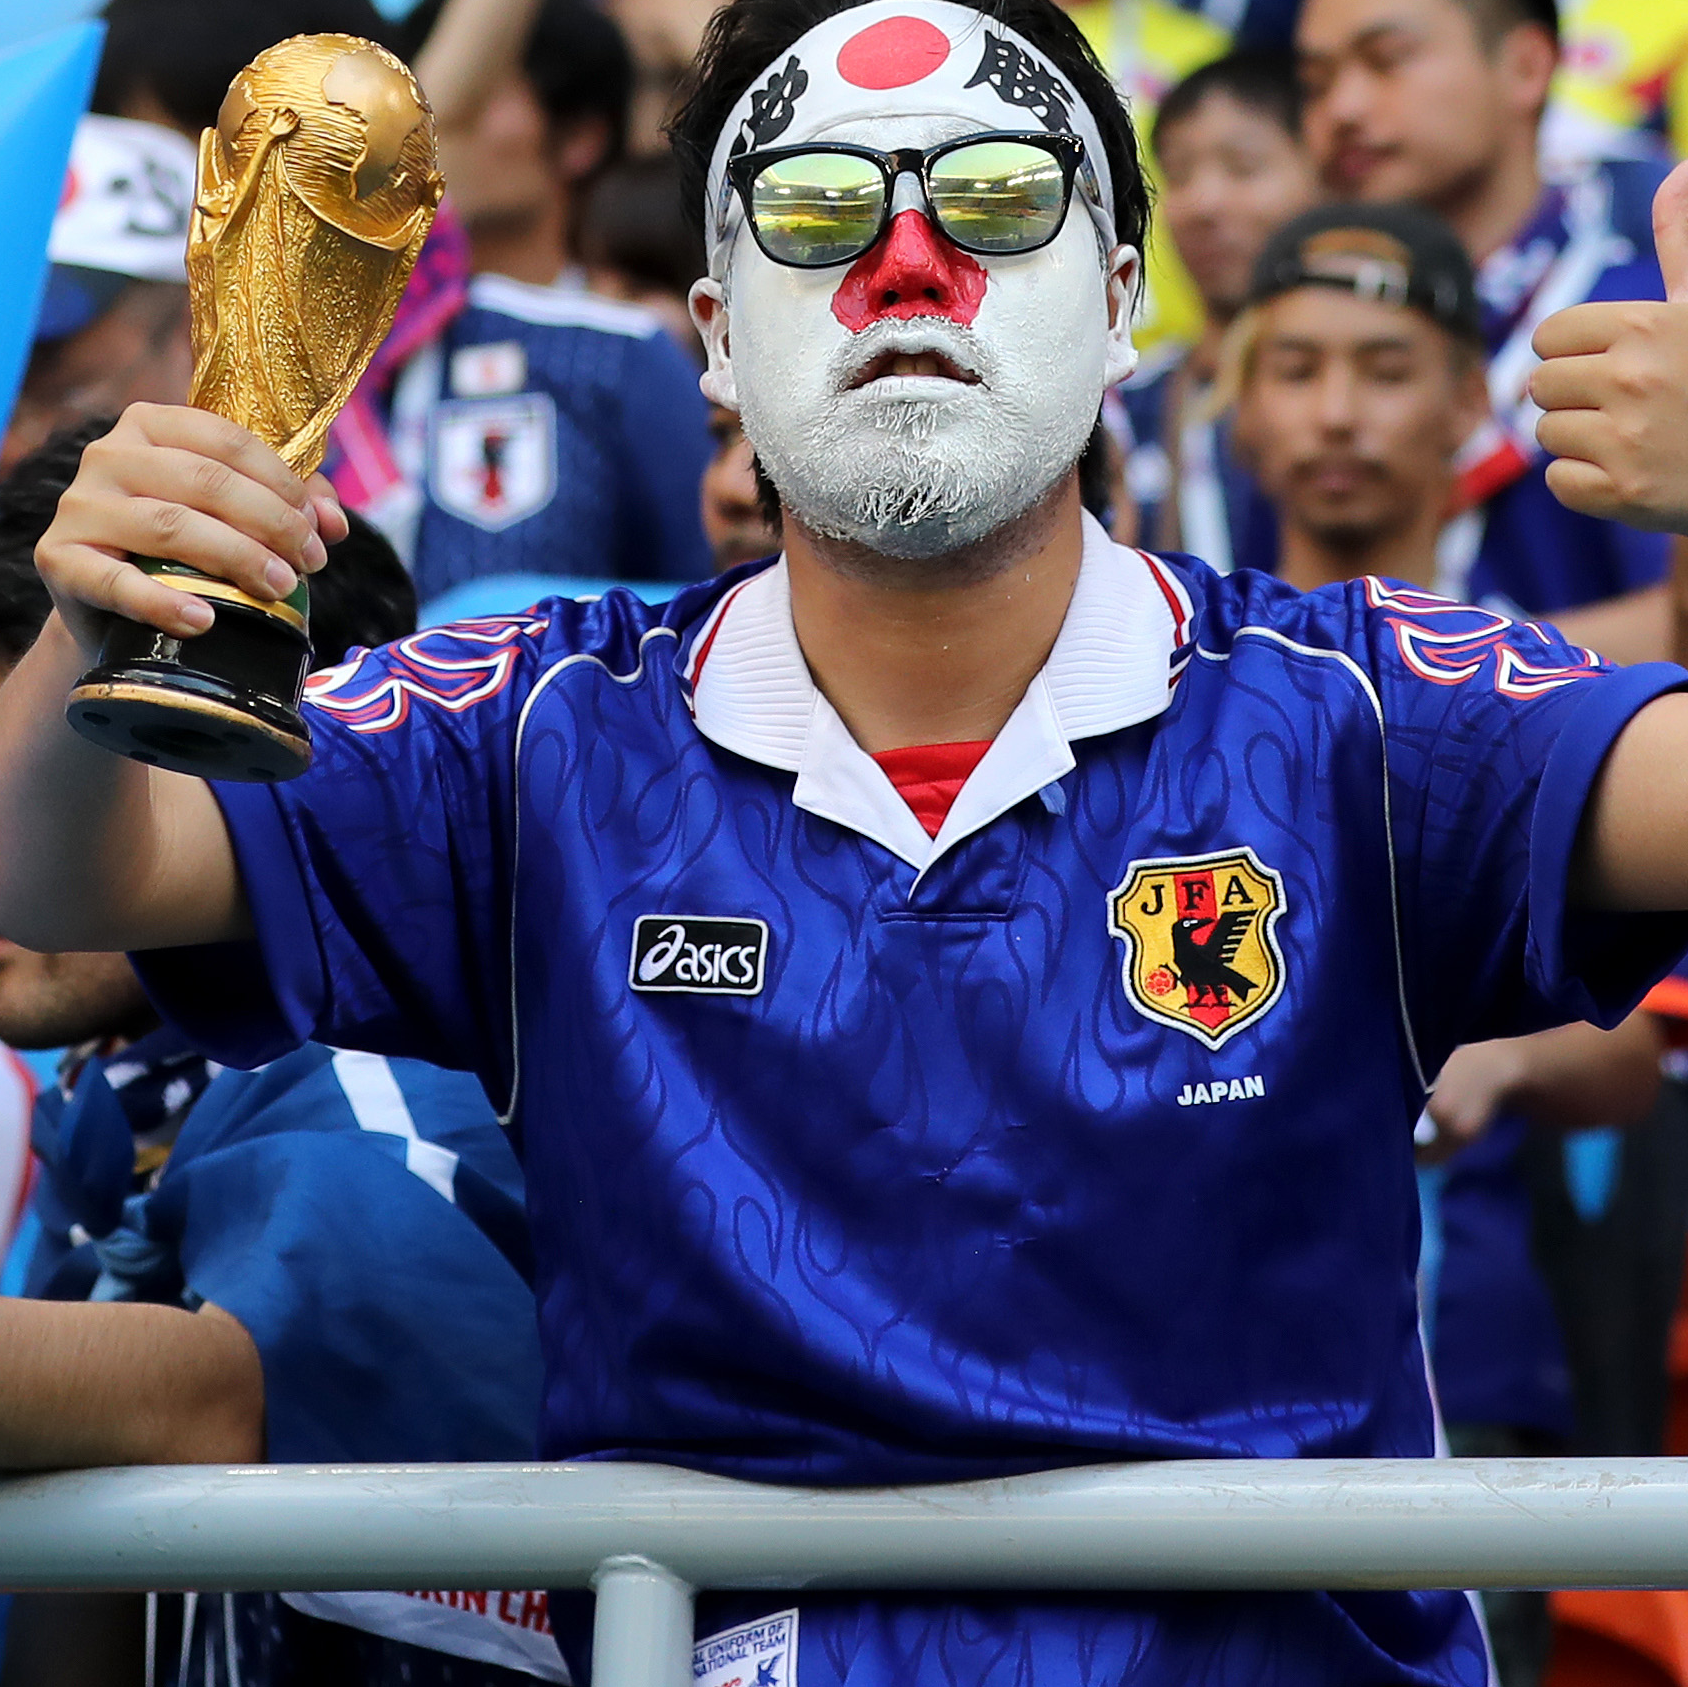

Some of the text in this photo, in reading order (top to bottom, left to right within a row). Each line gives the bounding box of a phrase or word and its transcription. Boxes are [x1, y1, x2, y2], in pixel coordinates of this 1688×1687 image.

[1140, 875, 1255, 916] JFA
[1176, 1075, 1266, 1107] JAPAN
[707, 1627, 766, 1658] UNIFORM
[767, 1620, 785, 1636] OF
[752, 1632, 787, 1654] TEAM
